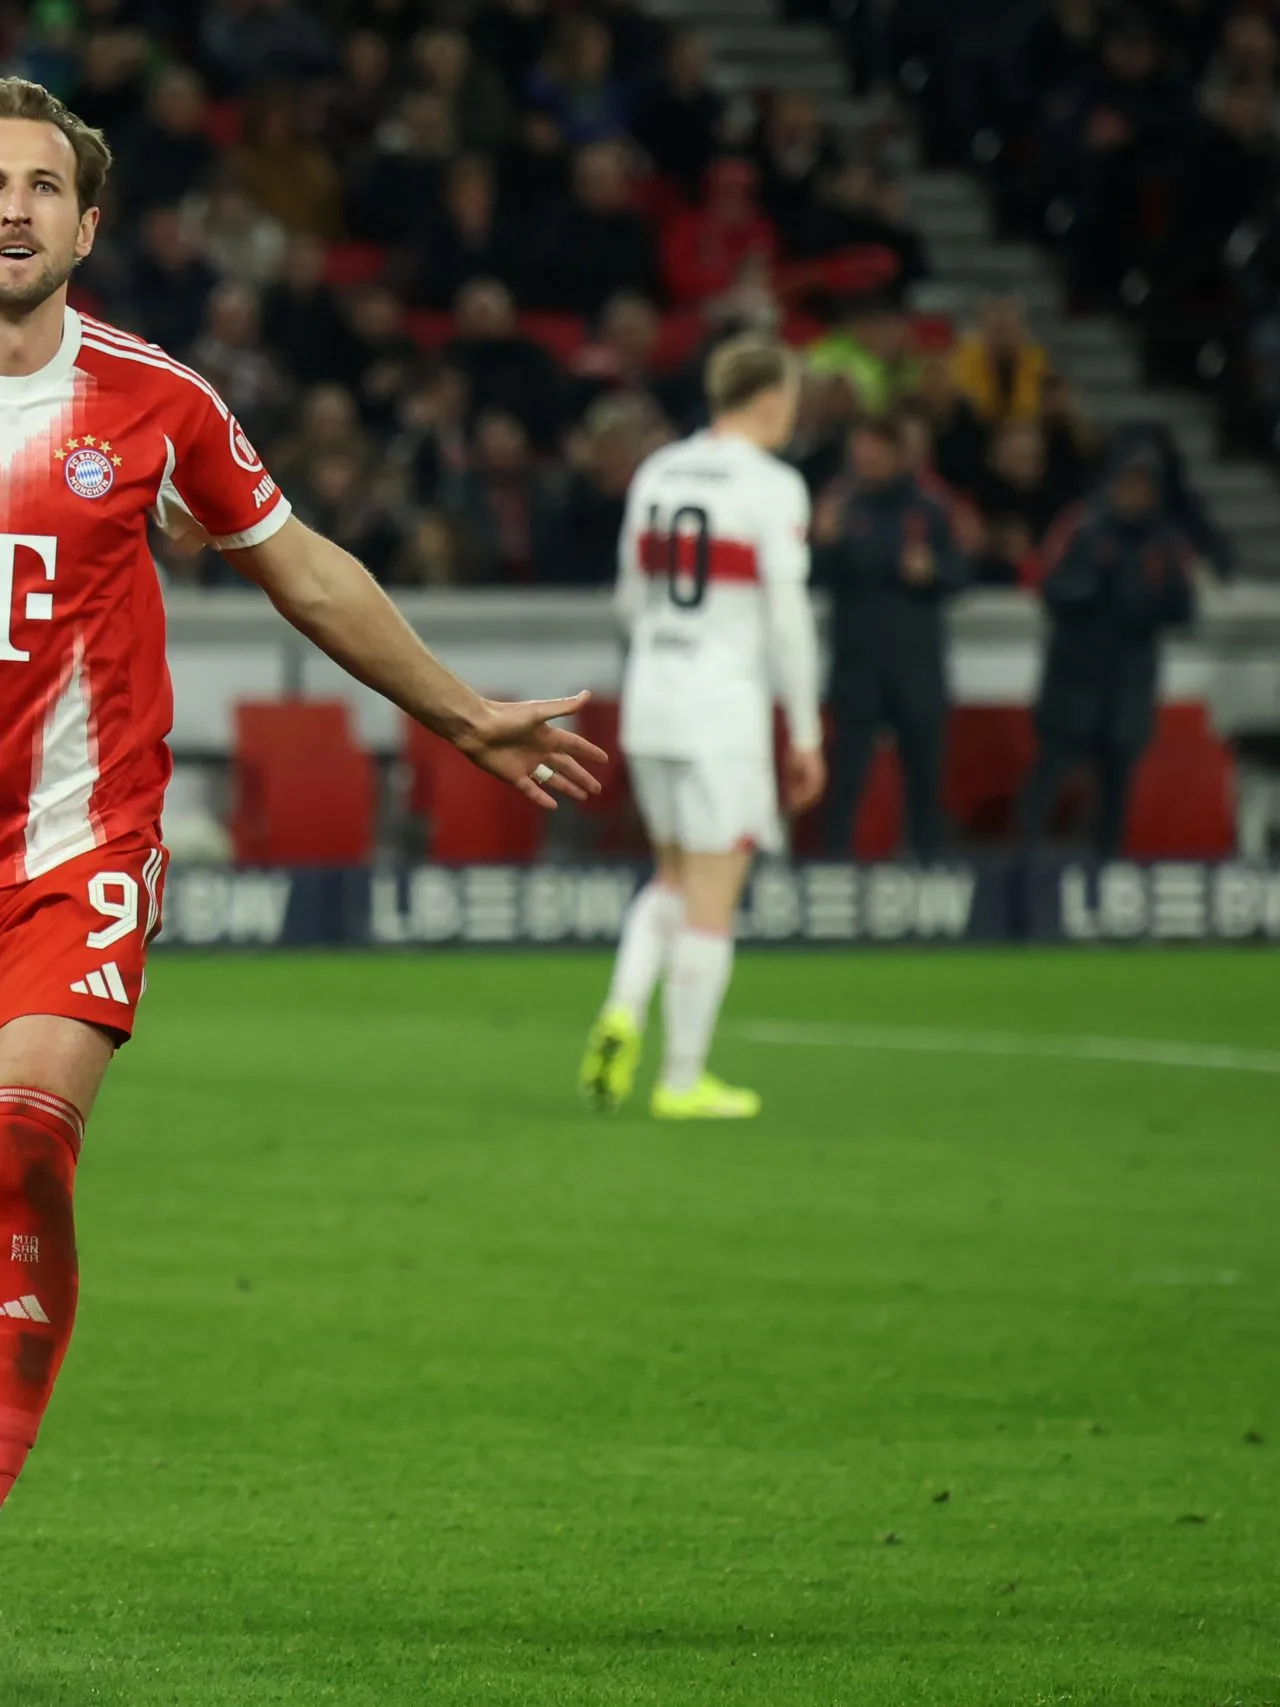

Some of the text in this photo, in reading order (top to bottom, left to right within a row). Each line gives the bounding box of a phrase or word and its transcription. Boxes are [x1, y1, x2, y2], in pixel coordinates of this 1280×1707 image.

[69, 453, 110, 472] FC BAYERN
[645, 503, 709, 608] 10
[86, 871, 138, 950] 9
[11, 1244, 39, 1254] SAN
[12, 1234, 39, 1245] MIA
